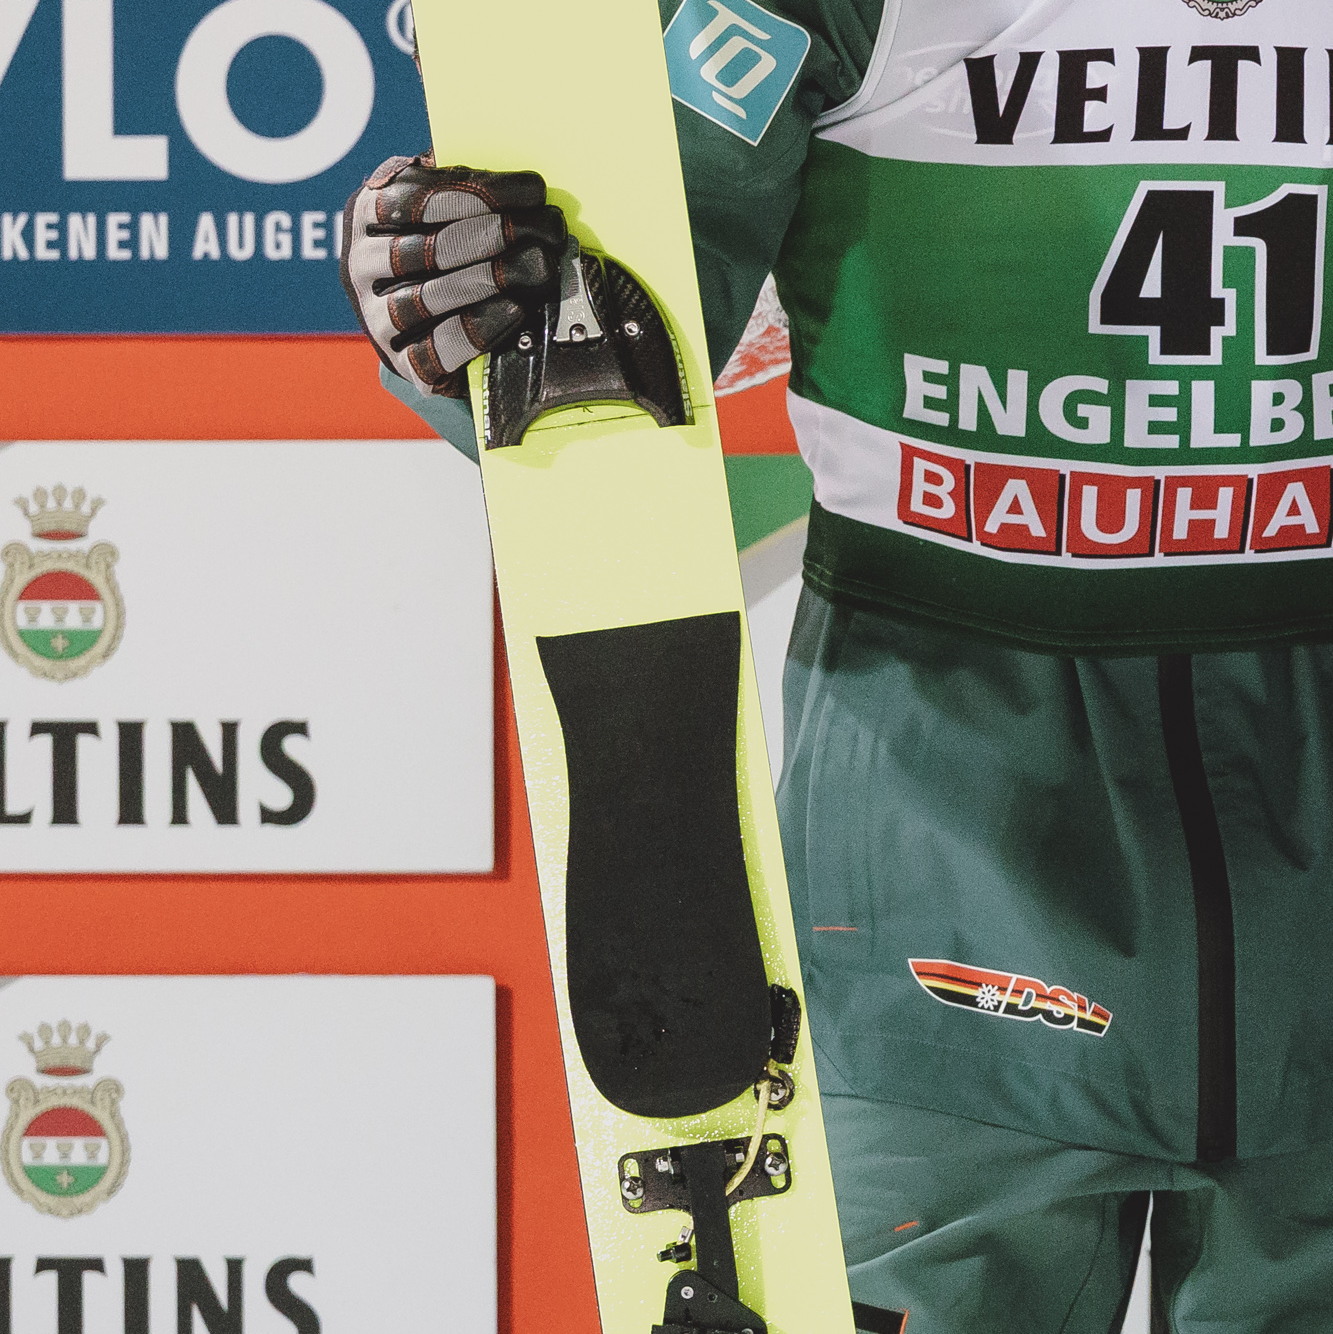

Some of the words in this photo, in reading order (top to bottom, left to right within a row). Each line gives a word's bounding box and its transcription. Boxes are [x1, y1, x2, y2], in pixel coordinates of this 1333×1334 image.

[1, 211, 170, 262] KENEN
[191, 210, 344, 261] AUGE
[1087, 179, 1329, 366] 41
[1002, 975, 1113, 1038] DSV
